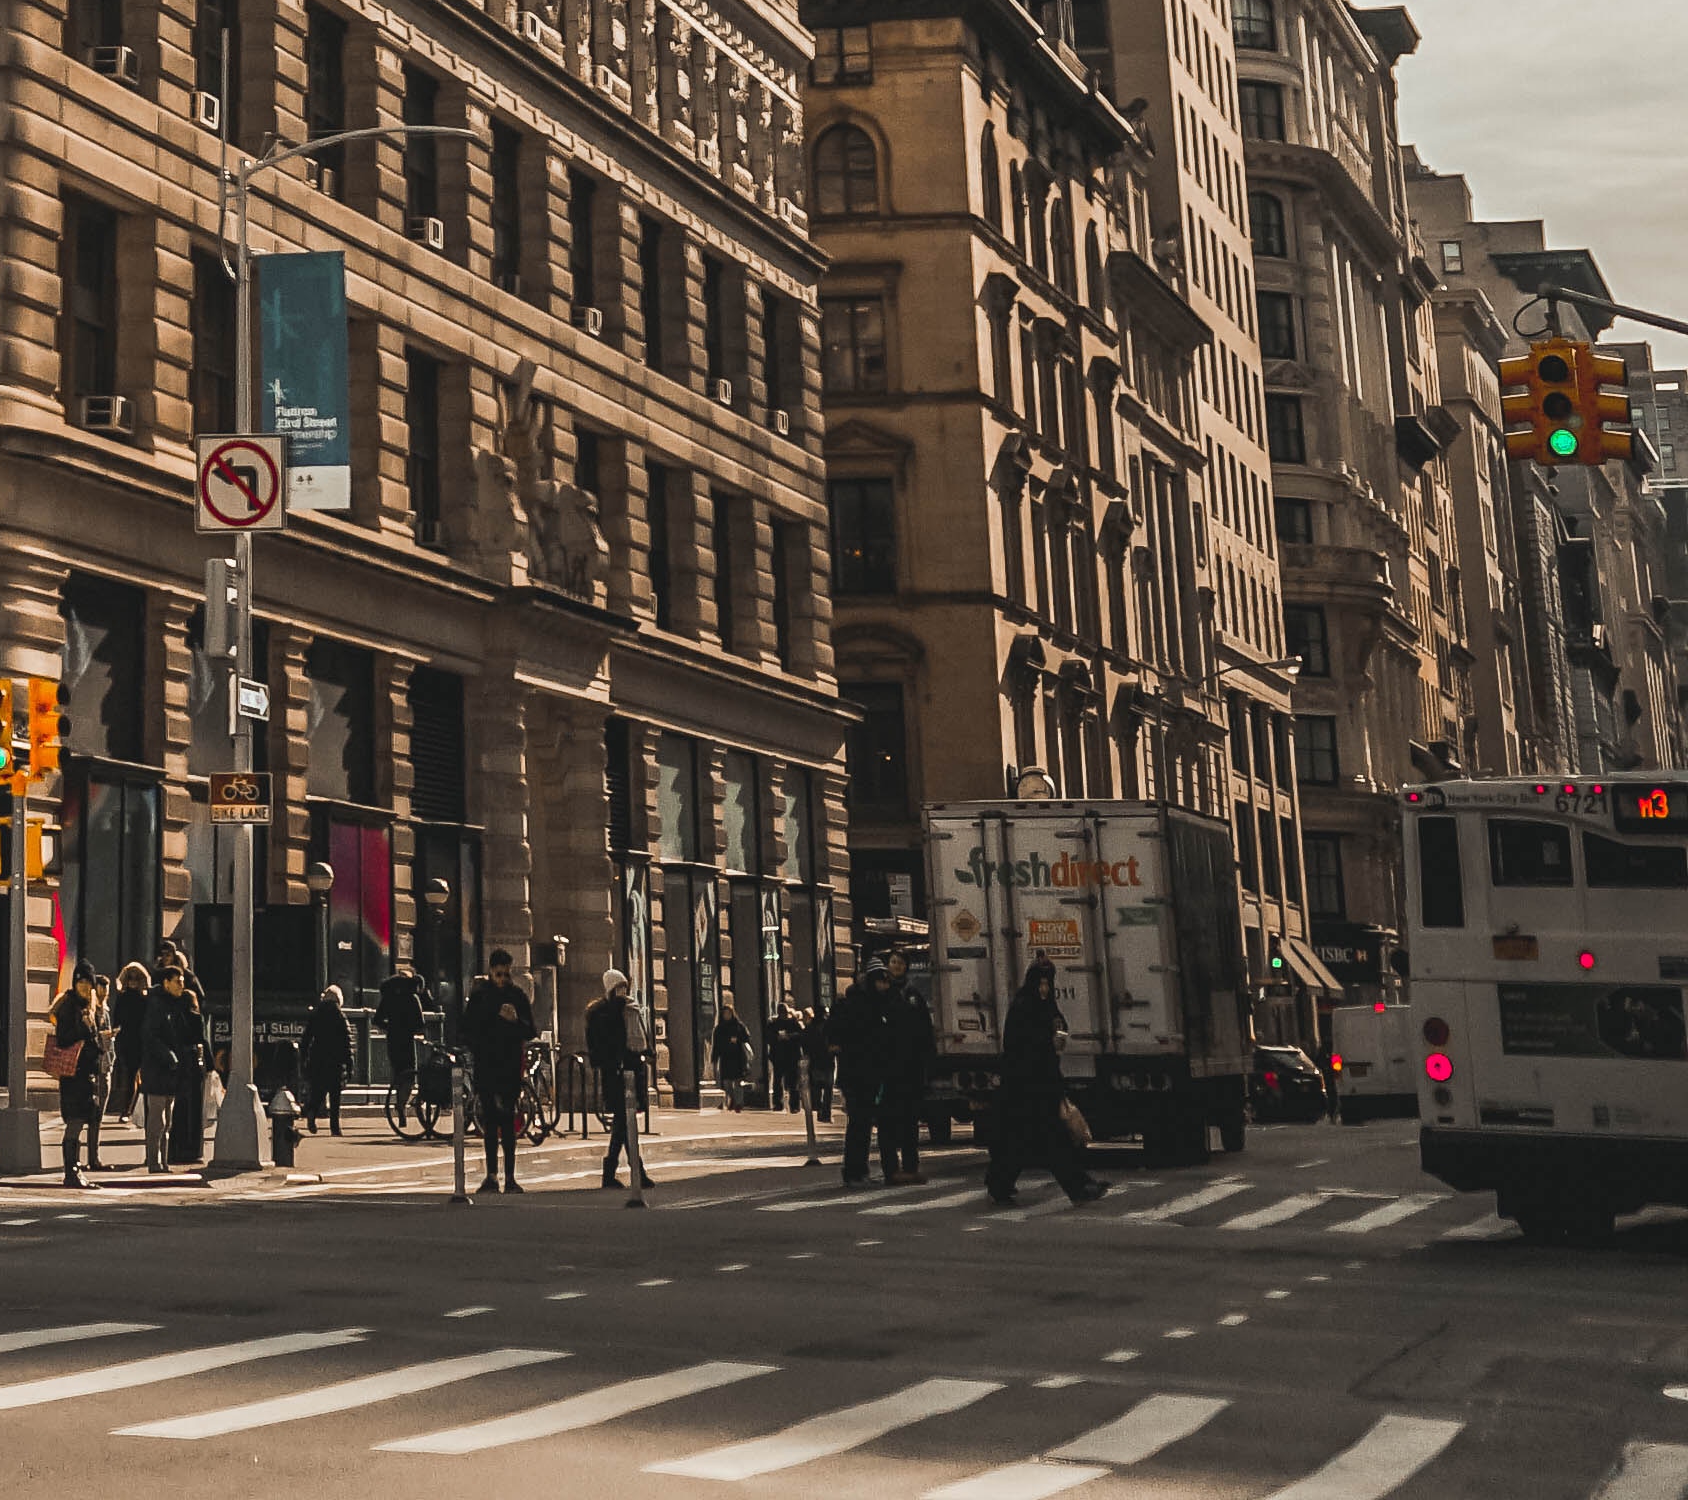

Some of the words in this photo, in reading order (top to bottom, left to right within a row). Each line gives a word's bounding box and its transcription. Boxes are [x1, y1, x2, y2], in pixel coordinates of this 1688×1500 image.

[1554, 792, 1609, 815] 6721
[240, 807, 269, 820] LANE
[1038, 922, 1067, 933] NOW
[215, 1022, 229, 1033] 23
[270, 1021, 305, 1035] Statio
